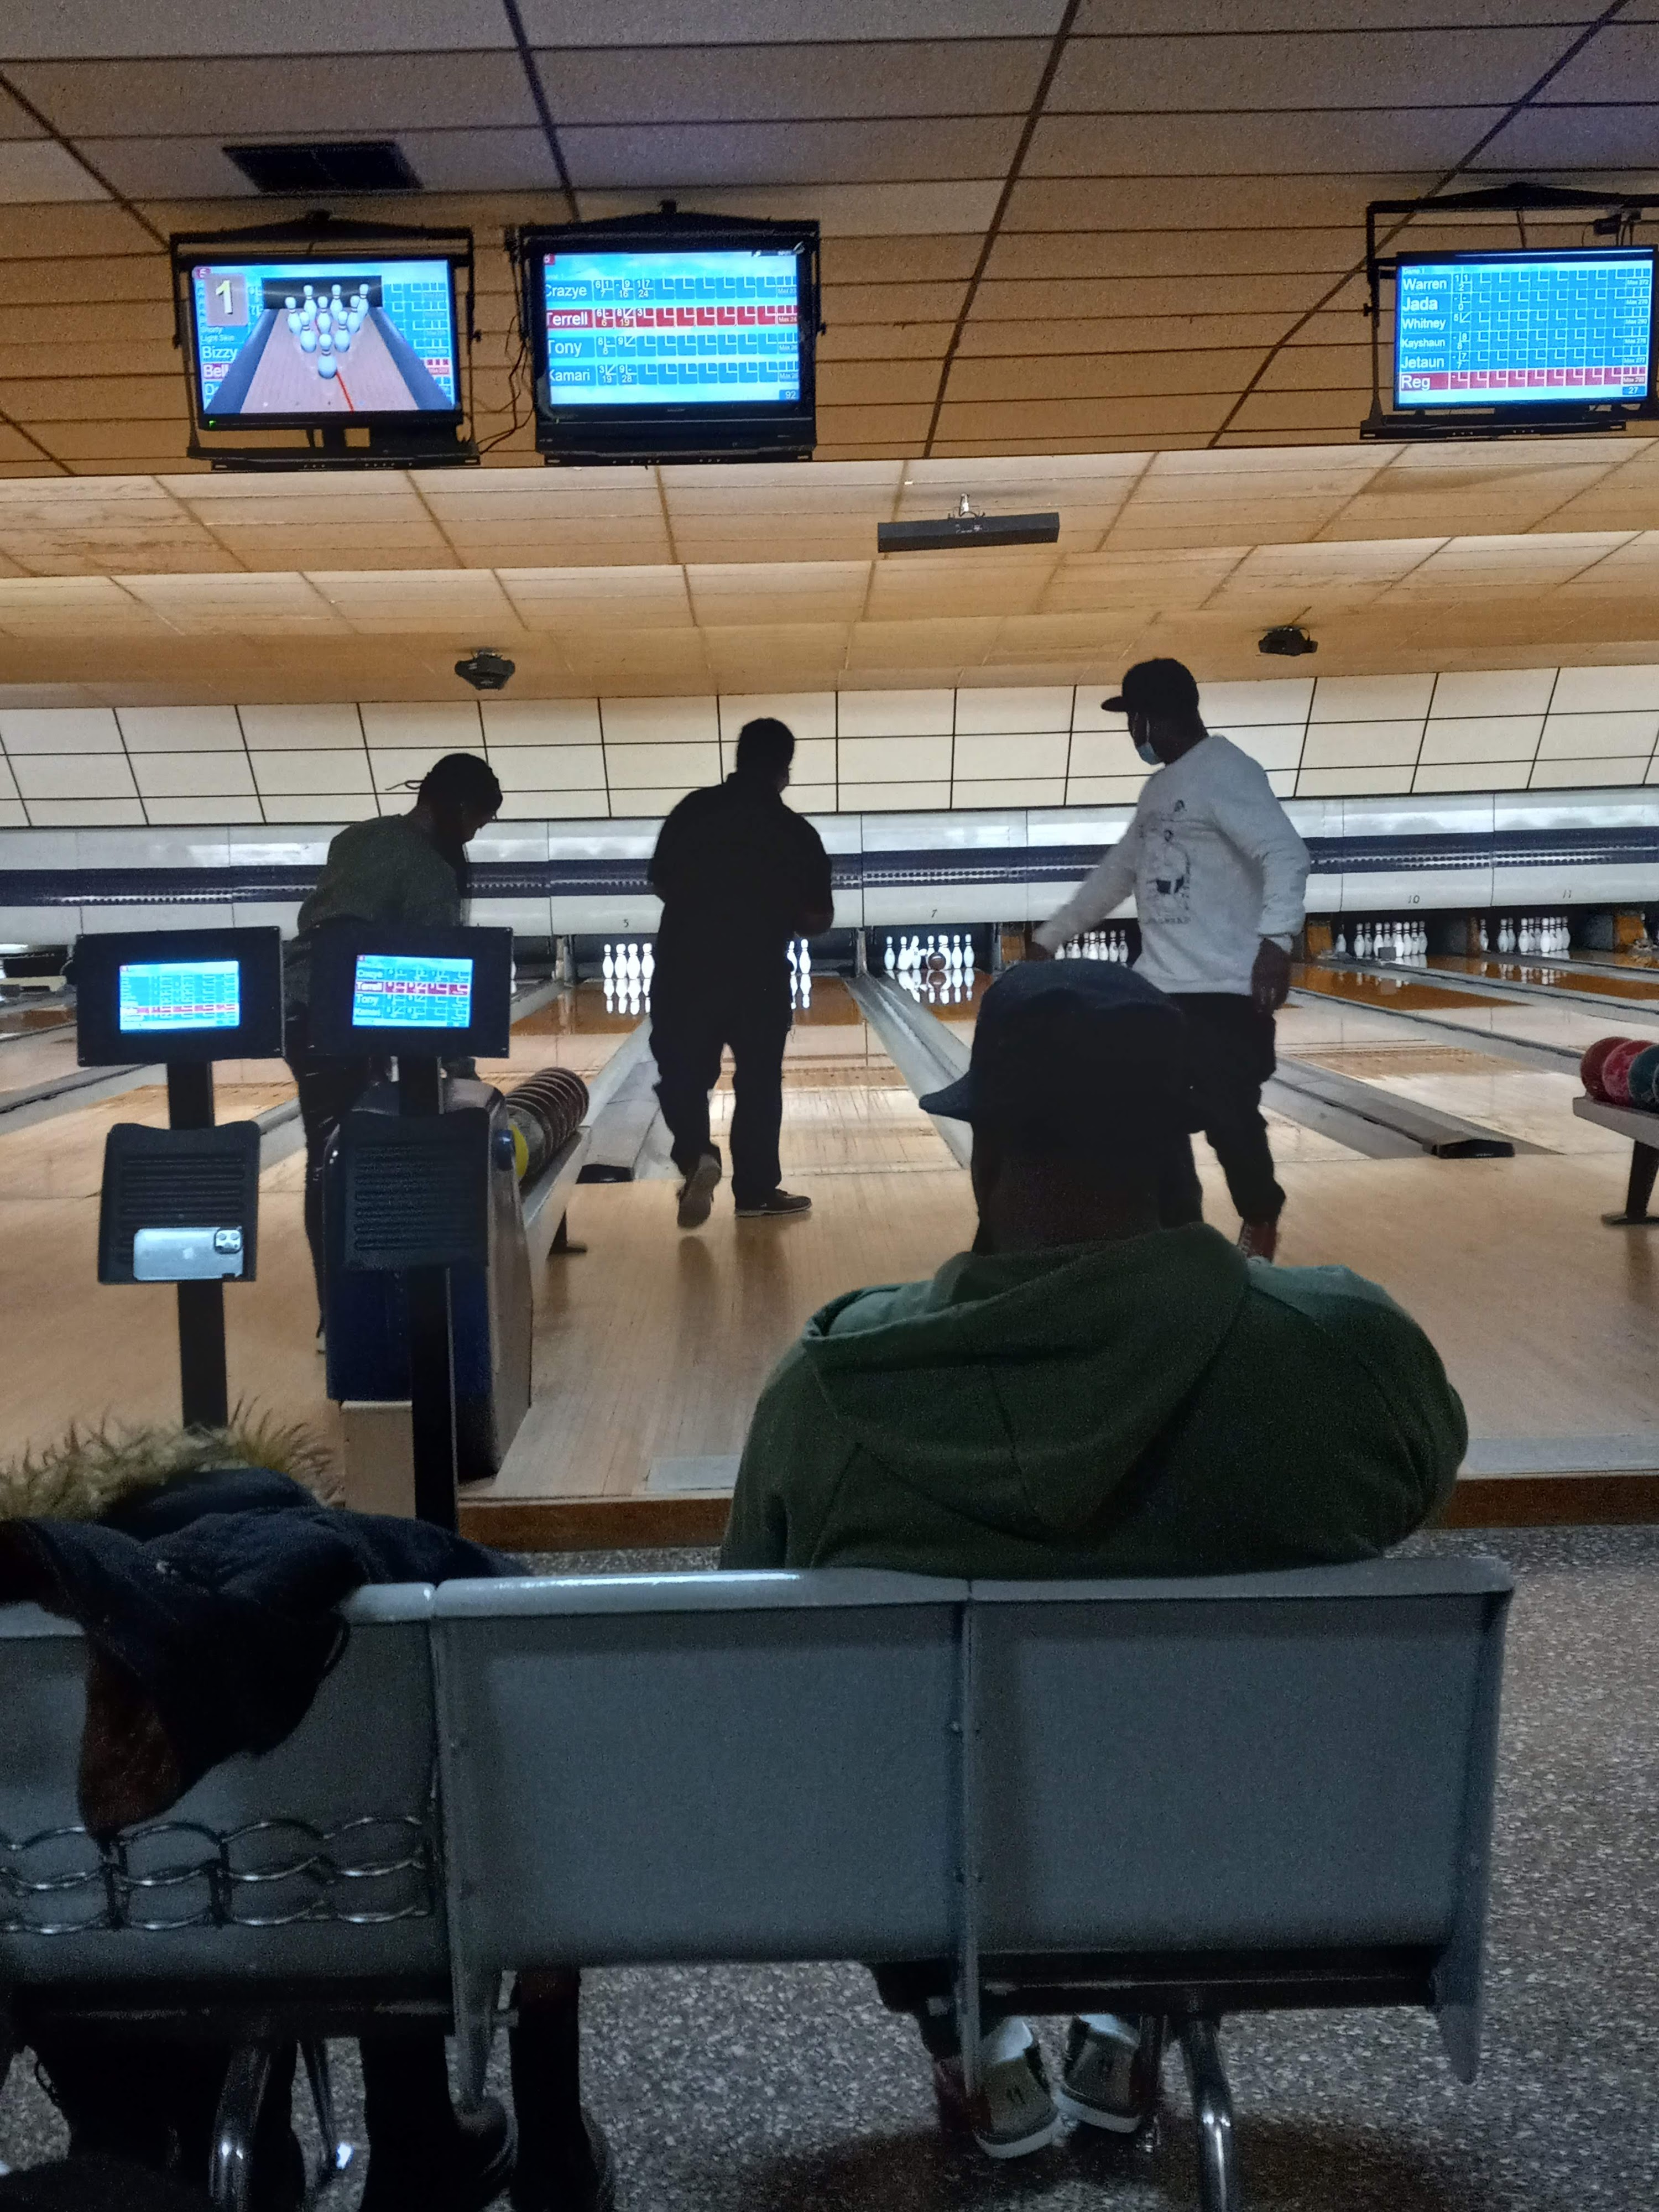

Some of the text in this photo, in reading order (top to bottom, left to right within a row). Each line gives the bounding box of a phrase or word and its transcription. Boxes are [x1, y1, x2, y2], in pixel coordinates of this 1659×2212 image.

[1402, 278, 1447, 290] Warren
[216, 280, 232, 314] 1
[545, 284, 587, 299] Crazye
[1402, 296, 1438, 311] Jada
[546, 312, 588, 326] Terrell
[1402, 318, 1446, 330] Whitney
[618, 337, 623, 345] 9
[1402, 338, 1445, 349] Kayshaun
[202, 346, 238, 361] Bizzy
[549, 340, 582, 357] Tony
[1401, 356, 1444, 368] Jetaun
[549, 369, 590, 381] Kamari
[1402, 375, 1431, 391] Reg
[785, 390, 796, 399] 92
[1408, 895, 1420, 904] 10
[931, 909, 937, 918] 7
[624, 919, 629, 927] 5
